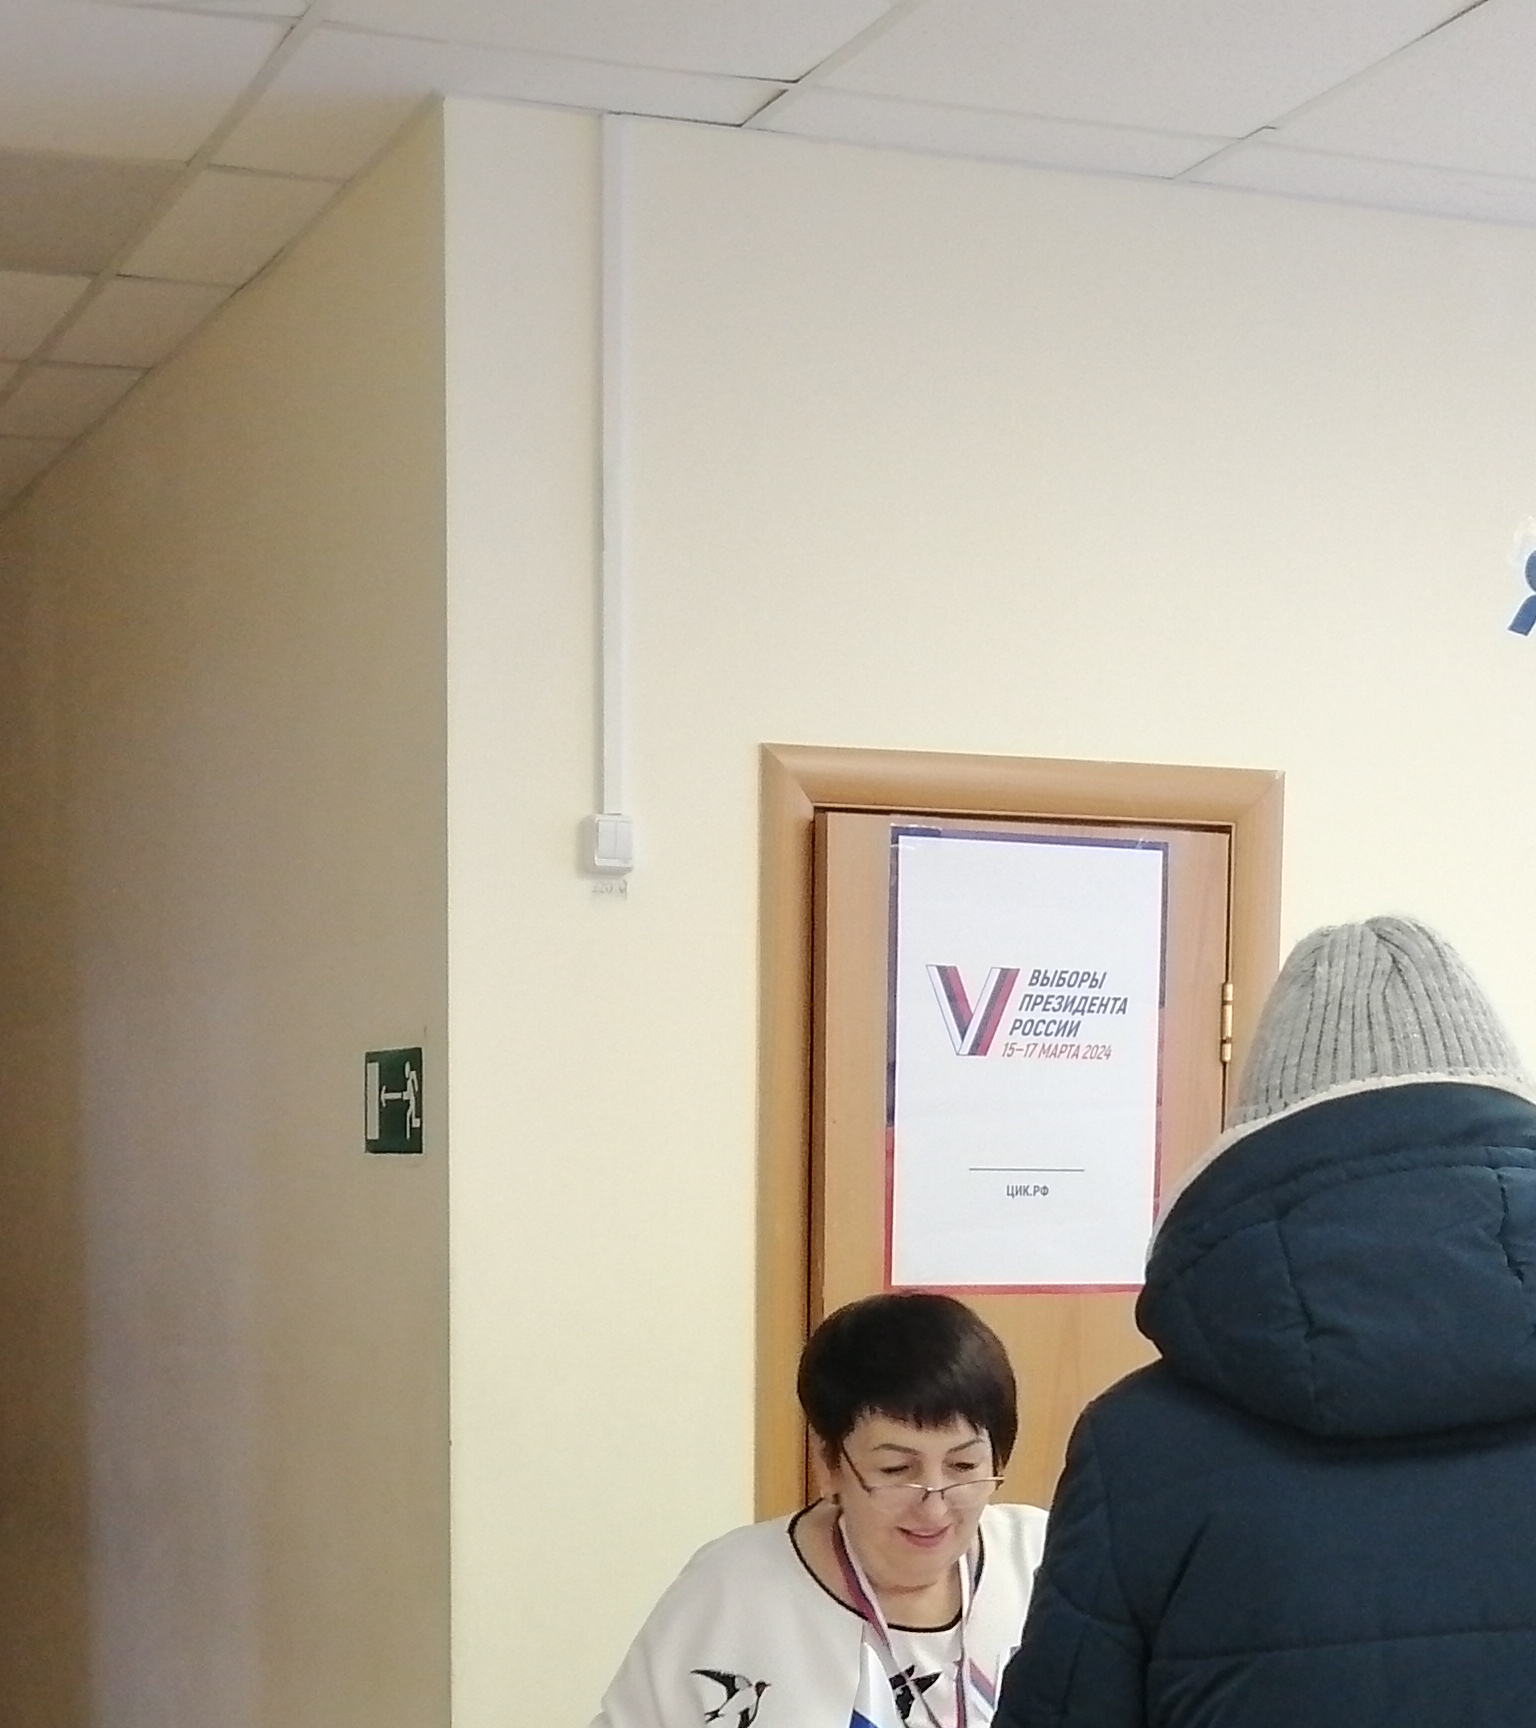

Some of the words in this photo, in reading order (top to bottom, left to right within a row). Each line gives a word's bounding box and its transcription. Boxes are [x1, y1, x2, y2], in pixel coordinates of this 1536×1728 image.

[1027, 968, 1108, 990] ВЫБОРЫ
[1018, 993, 1129, 1016] ПРЕЗИДЕНТА
[1008, 1018, 1082, 1038] РОССИИ
[1037, 1042, 1082, 1060] МАРТА
[1081, 1044, 1113, 1061] 2024
[1006, 1184, 1050, 1199] ЦИК.РФ
